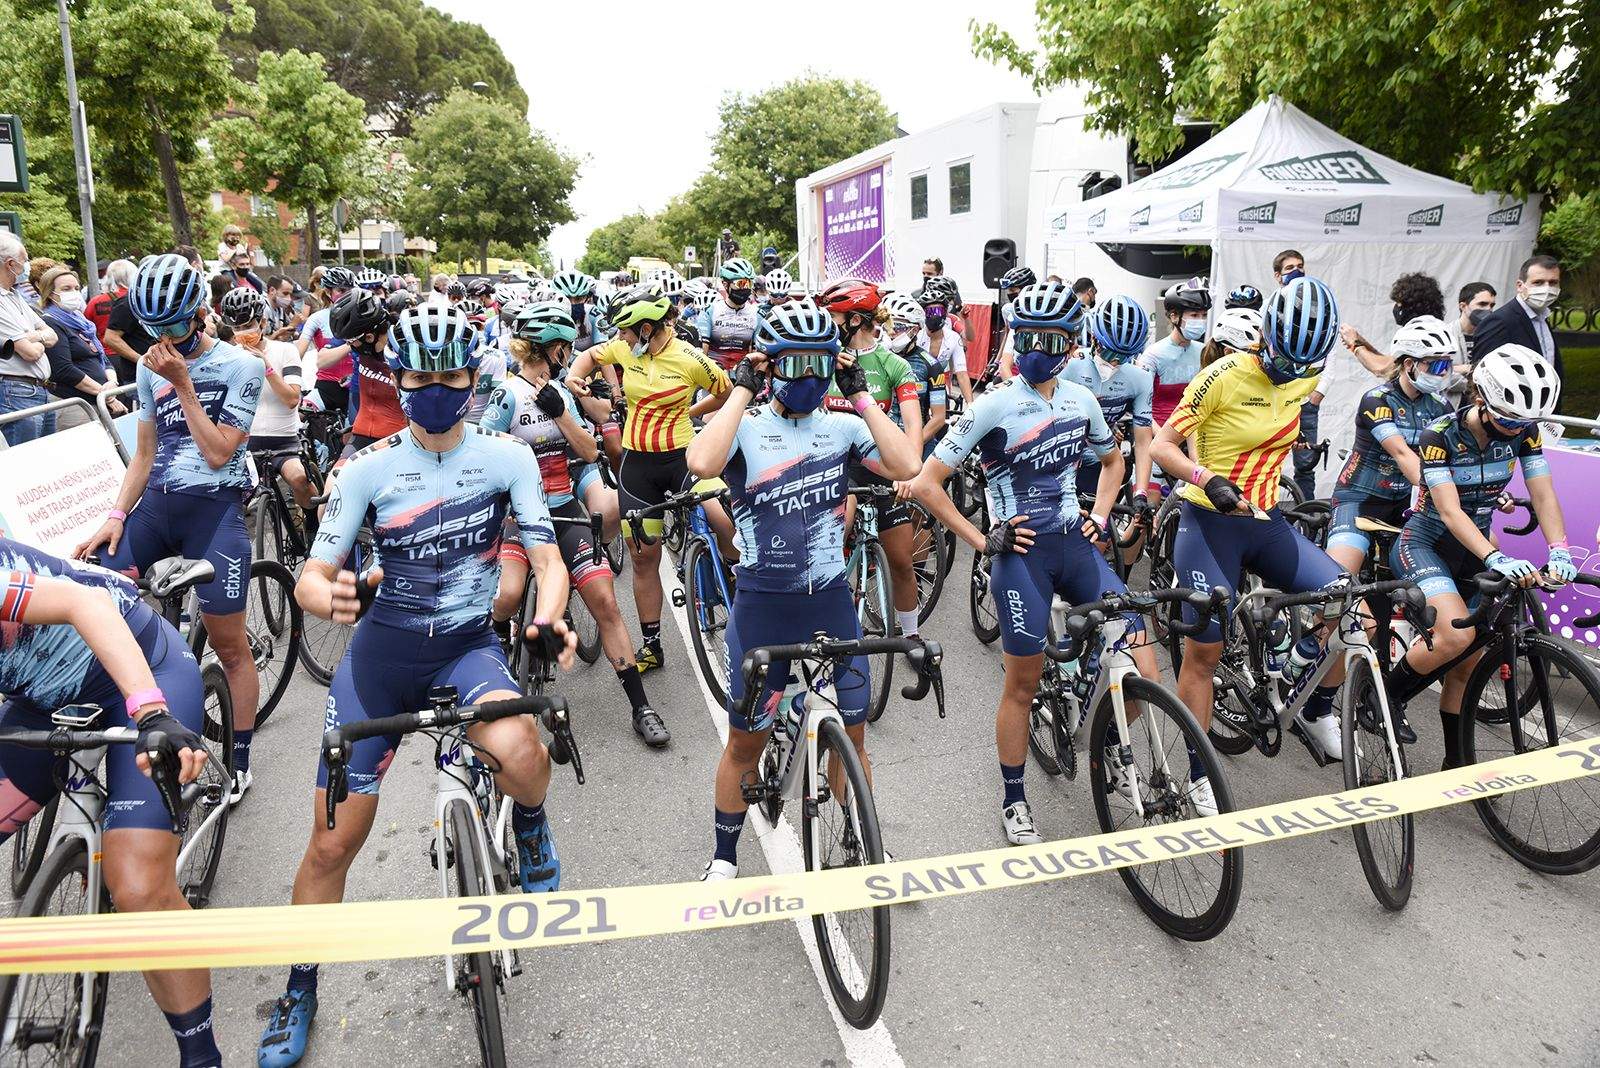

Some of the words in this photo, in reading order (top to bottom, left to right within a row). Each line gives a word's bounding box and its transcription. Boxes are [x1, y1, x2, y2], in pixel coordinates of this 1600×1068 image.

[1262, 156, 1375, 180] FINISHER
[1239, 206, 1273, 221] FINISHER
[1325, 208, 1358, 224] FINISHER
[1408, 208, 1440, 224] FINISHER
[1487, 208, 1519, 224] FINISHER
[1030, 440, 1082, 470] TACTIC
[16, 484, 54, 508] AJUDEM
[59, 471, 82, 490] NENS
[27, 505, 49, 525] AMB
[48, 475, 119, 516] TRASPLANTAMENTS
[773, 483, 840, 516] TACTIC
[43, 512, 87, 541] MALALTIES
[402, 528, 487, 560] TACTIC
[219, 553, 241, 599] etixx
[1007, 589, 1033, 634] etixx
[325, 695, 340, 735] etix
[1441, 773, 1538, 799] reVolta
[865, 863, 988, 900] SANT
[1001, 840, 1148, 880] CUGAT
[1154, 826, 1244, 855] DEL
[1238, 797, 1400, 837] VALLÈS
[452, 896, 617, 945] 2021
[684, 894, 804, 922] reVolta
